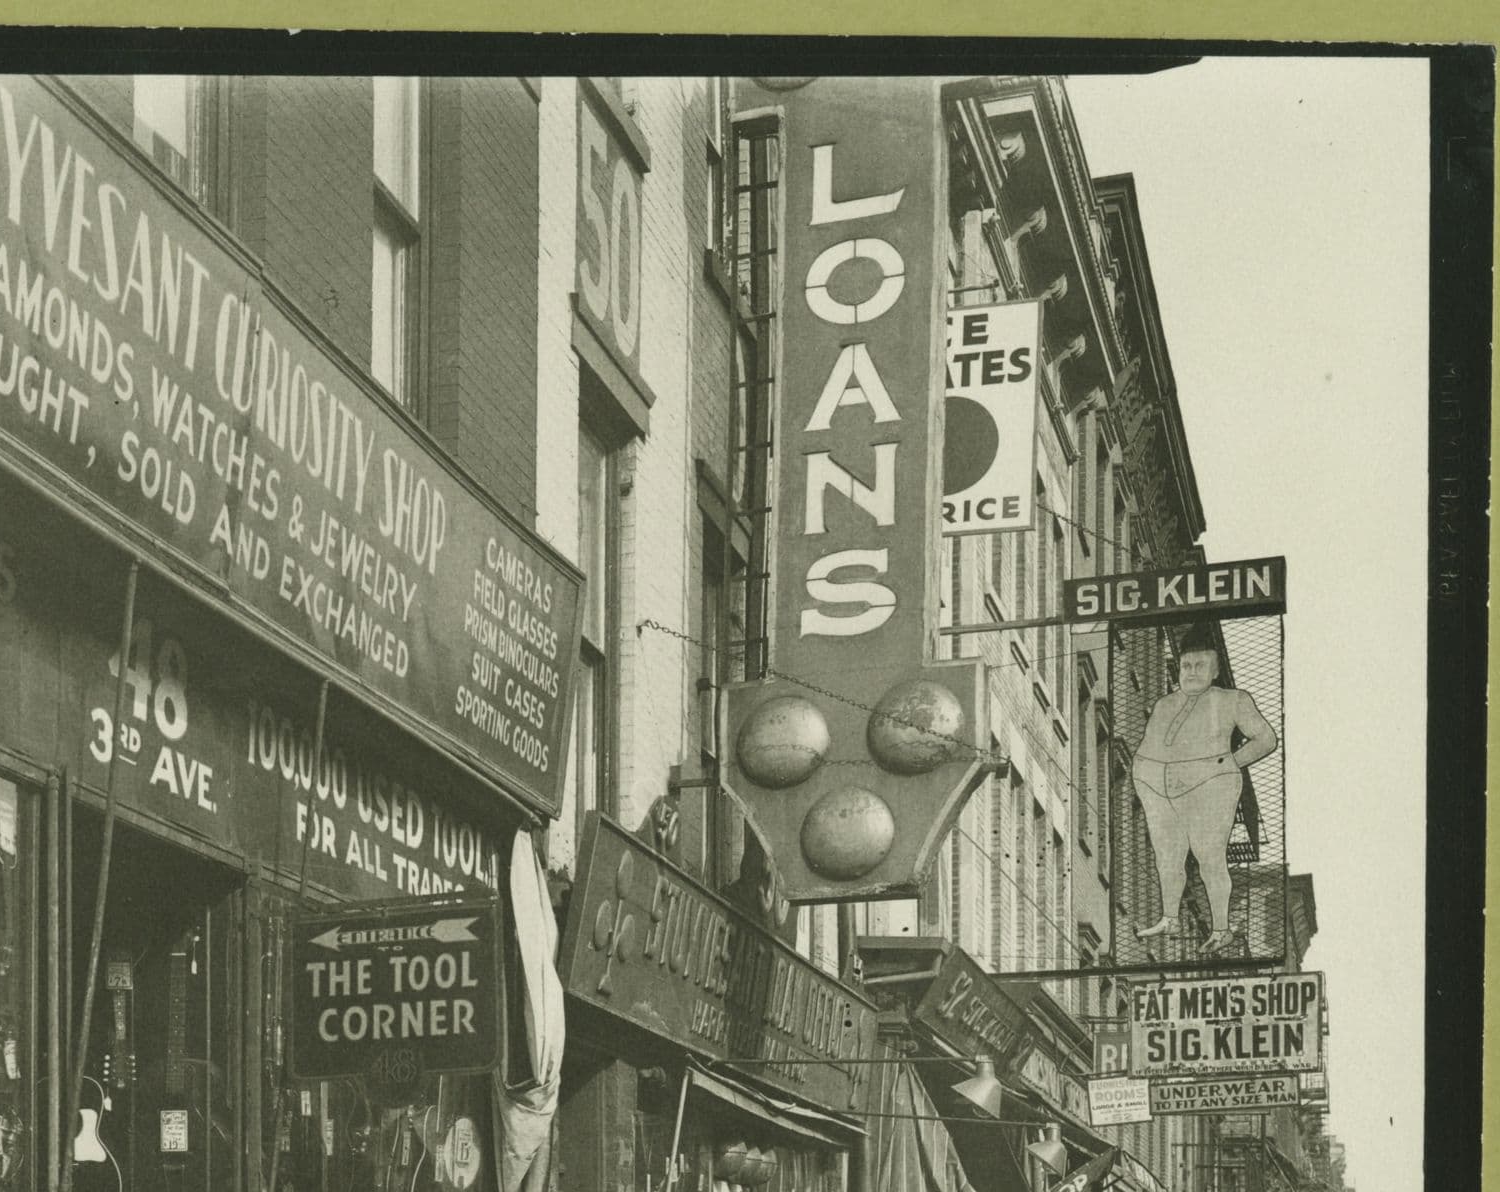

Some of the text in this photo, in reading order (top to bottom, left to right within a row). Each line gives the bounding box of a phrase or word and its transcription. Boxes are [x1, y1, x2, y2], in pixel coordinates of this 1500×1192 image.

[801, 142, 905, 638] LOANS
[216, 294, 374, 514] CURIOSITY
[379, 448, 445, 576] SHOP
[153, 366, 280, 520] WATCHES
[288, 494, 304, 542] &
[311, 510, 417, 621] JEWELRY
[118, 431, 196, 524] SOLD
[210, 504, 270, 579] AND
[279, 556, 409, 677] EXCHANGED
[487, 537, 552, 613] CAMERAS
[1077, 565, 1270, 616] SIG. KLEIN
[464, 604, 559, 698] PRISM BINOCULARS
[474, 569, 557, 660] FIELD GLASSES
[108, 618, 188, 741] 48
[472, 652, 545, 729] SUIT CASES
[455, 685, 549, 772] SPORTING GOODS
[150, 746, 217, 813] AVE.
[357, 770, 424, 849] USED
[345, 829, 388, 882] ALL
[306, 951, 478, 998] THE TOOL
[1133, 981, 1316, 1022] FAT MEN'S SHOP
[319, 999, 476, 1042] CORNER
[1147, 1023, 1304, 1063] SIG. KLEIN
[1155, 1101, 1171, 1111] TO
[1176, 1099, 1196, 1110] FIT
[1200, 1097, 1227, 1108] ANY
[1232, 1094, 1261, 1106] SIZE
[1266, 1092, 1296, 1103] MAN
[1159, 1080, 1286, 1101] UNDERWEAR
